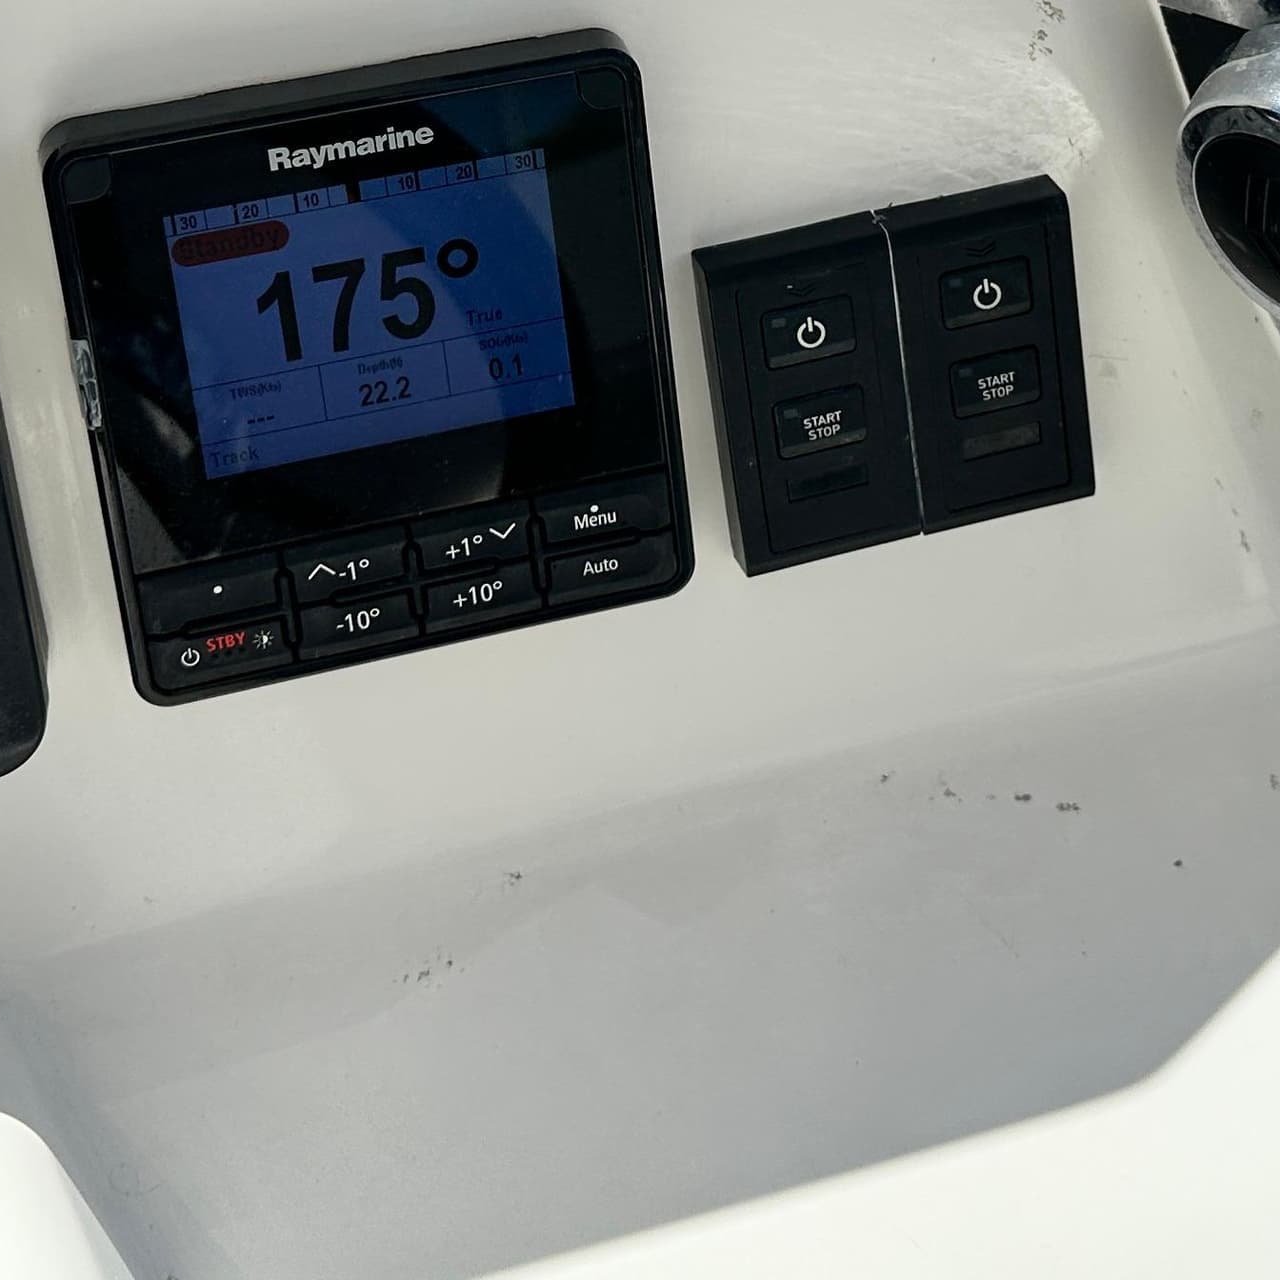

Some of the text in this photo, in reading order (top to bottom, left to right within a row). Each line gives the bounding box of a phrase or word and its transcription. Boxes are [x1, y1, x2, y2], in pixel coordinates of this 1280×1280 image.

[267, 125, 435, 172] Raymarine
[179, 154, 532, 231] 30 20 10 10 20 30
[256, 237, 479, 363] 175°
[466, 307, 504, 326] True
[488, 353, 524, 381] 0.1
[358, 375, 413, 408] 22.2
[976, 371, 1016, 391] START
[981, 384, 1015, 402] STOP
[802, 410, 843, 430] START
[807, 423, 842, 441] STOP
[210, 444, 260, 469] Track
[573, 509, 618, 532] Menu
[444, 533, 484, 562] +1°
[582, 555, 620, 577] Auto
[452, 579, 504, 609] +10°
[205, 631, 246, 653] STBY
